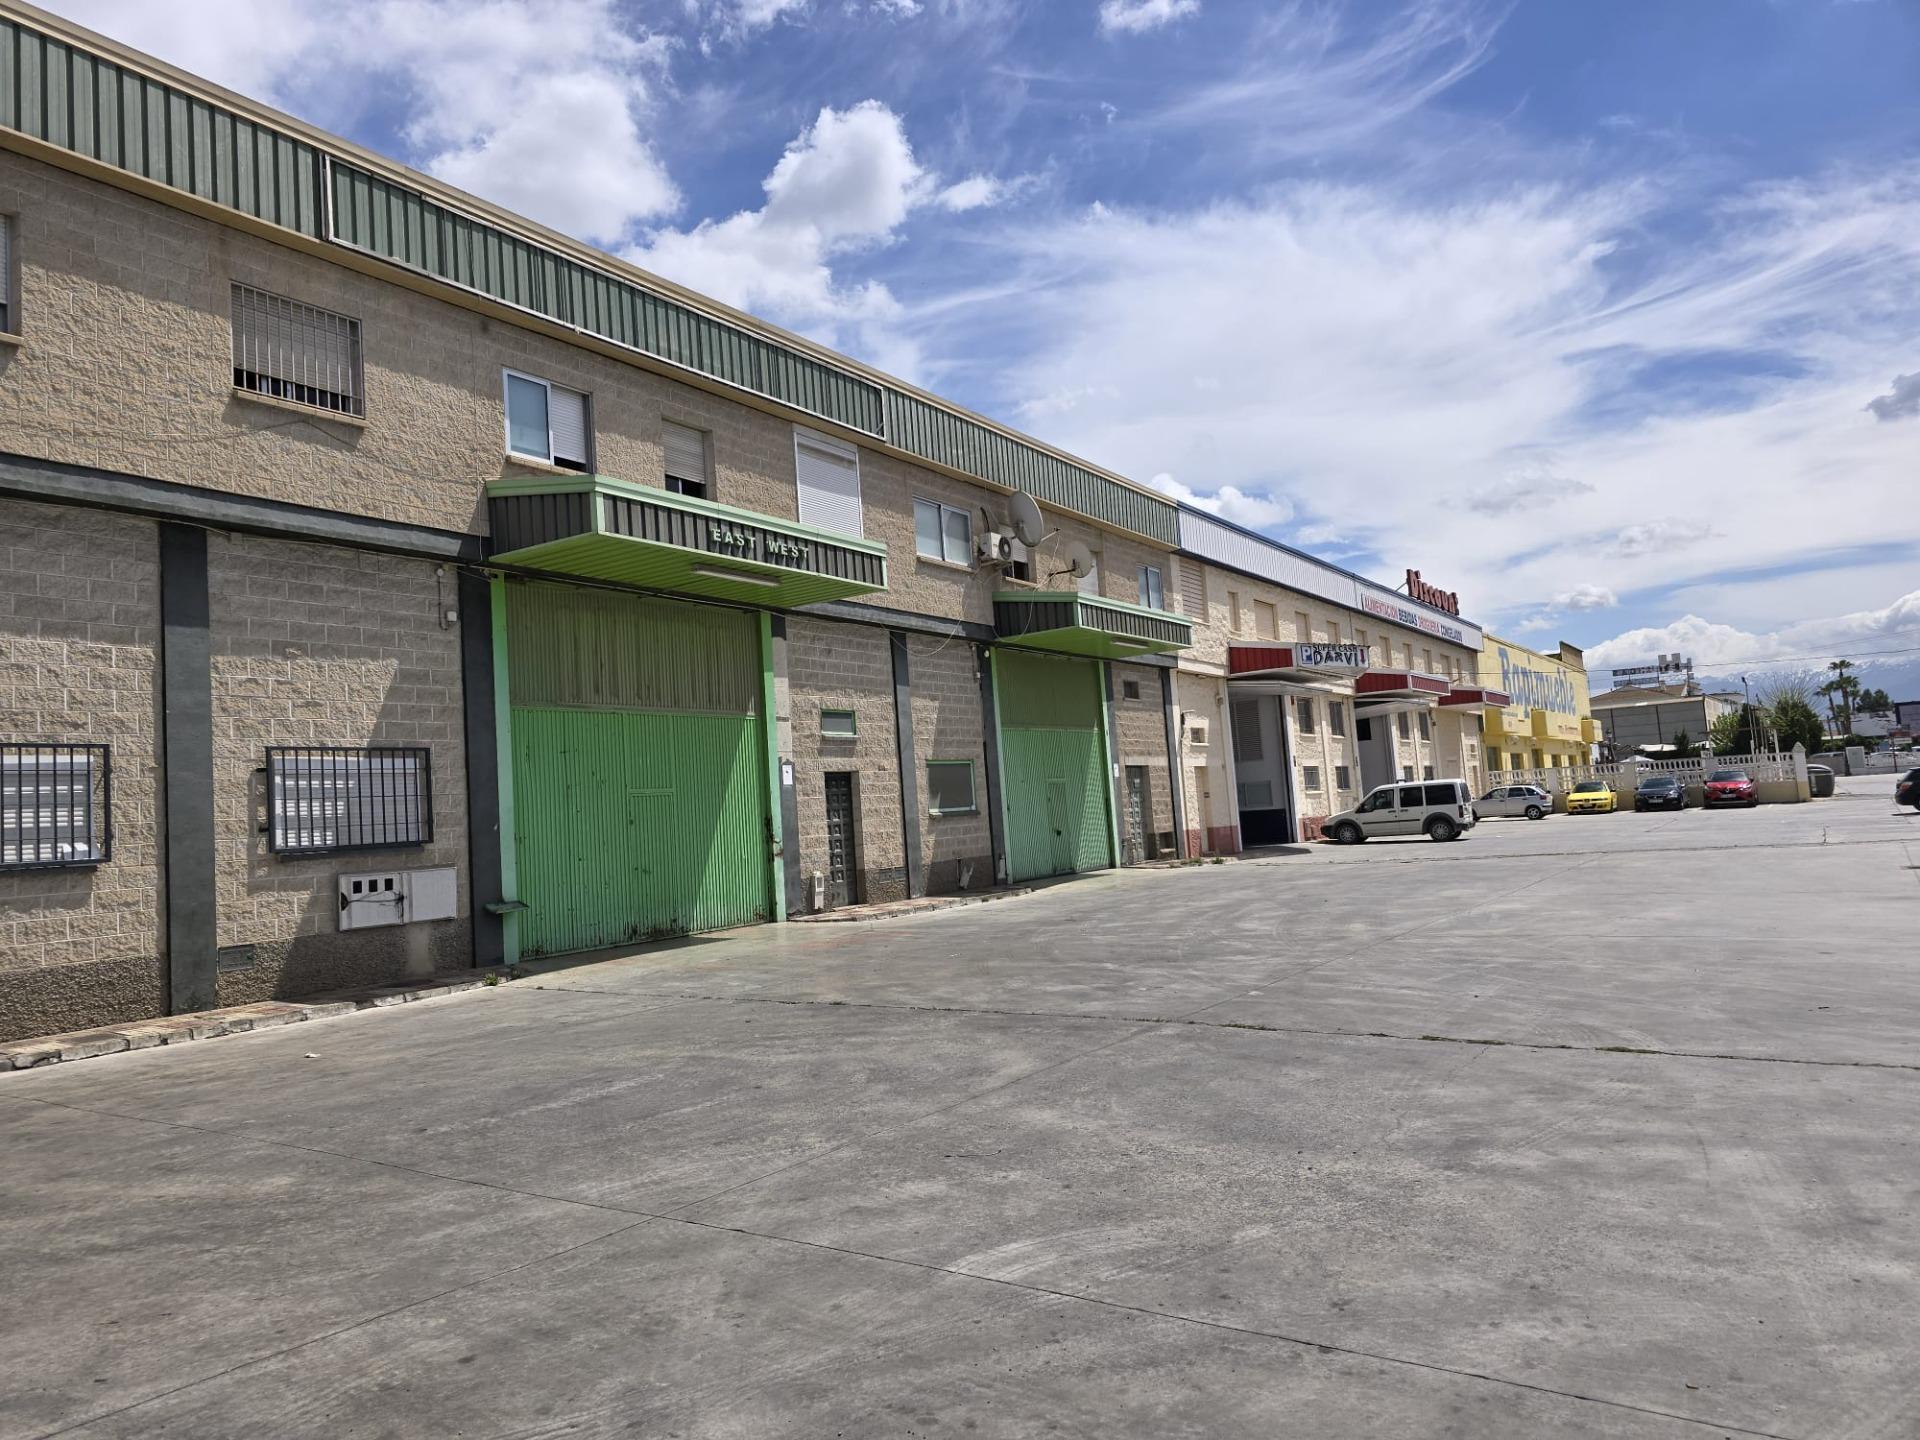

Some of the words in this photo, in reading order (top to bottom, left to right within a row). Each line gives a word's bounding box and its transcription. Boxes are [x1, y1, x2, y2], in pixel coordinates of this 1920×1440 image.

[711, 528, 756, 549] EAST
[767, 540, 809, 559] WEST
[1313, 643, 1336, 651] SUPER
[1338, 644, 1358, 652] CASH
[1313, 650, 1359, 667] DARVI
